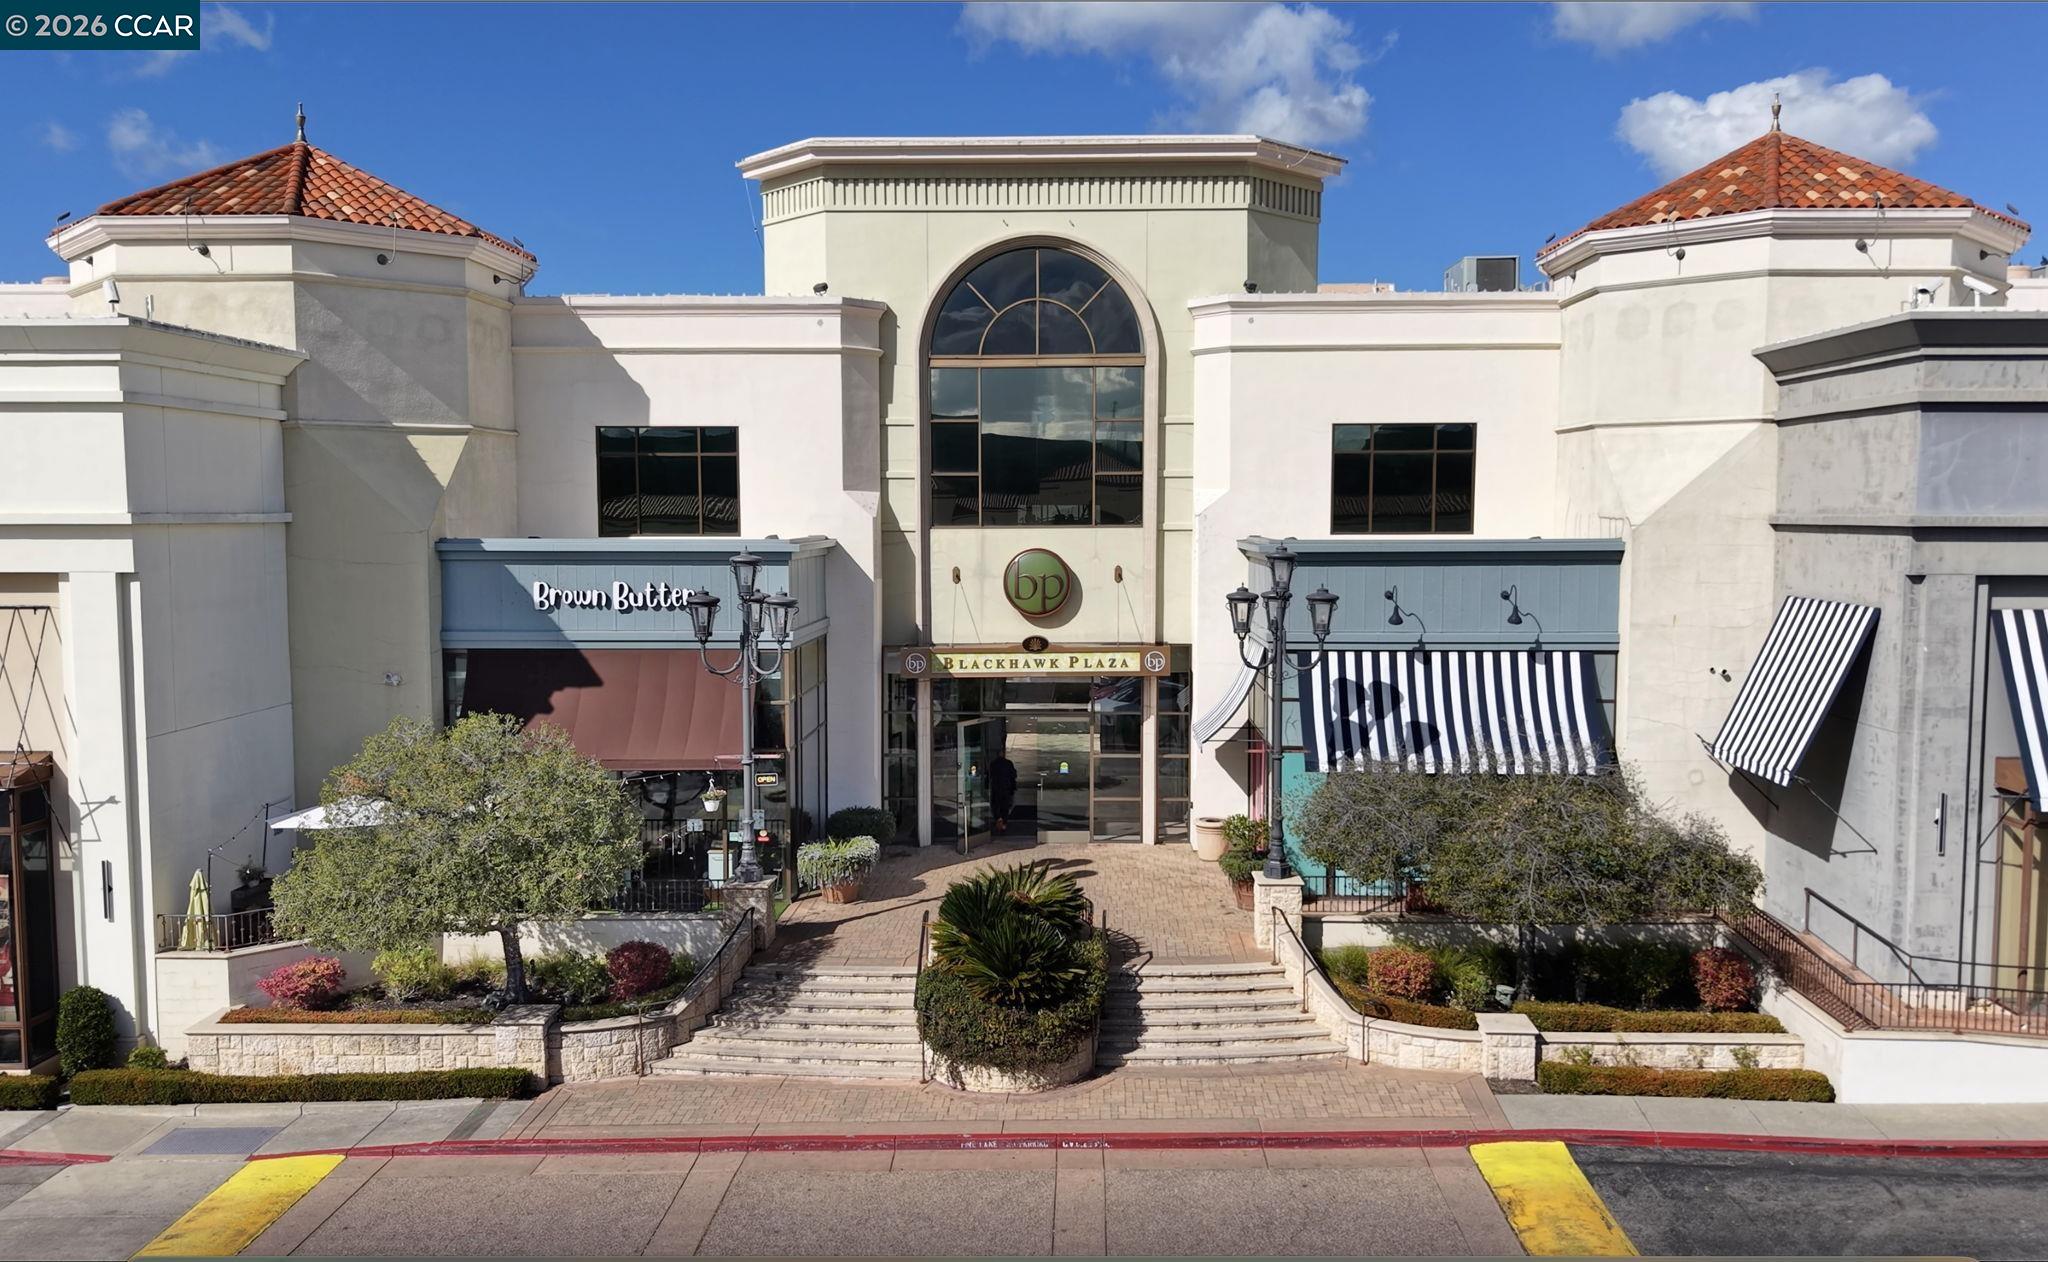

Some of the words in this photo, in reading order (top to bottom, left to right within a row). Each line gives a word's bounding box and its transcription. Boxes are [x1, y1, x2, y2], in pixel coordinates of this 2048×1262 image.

[1013, 558, 1065, 614] bp
[533, 581, 606, 611] Brown
[613, 581, 695, 610] Butter
[908, 655, 925, 673] bp
[942, 657, 1060, 670] BLACKHAWK
[1069, 656, 1129, 669] PLAZA
[1146, 653, 1164, 671] bp
